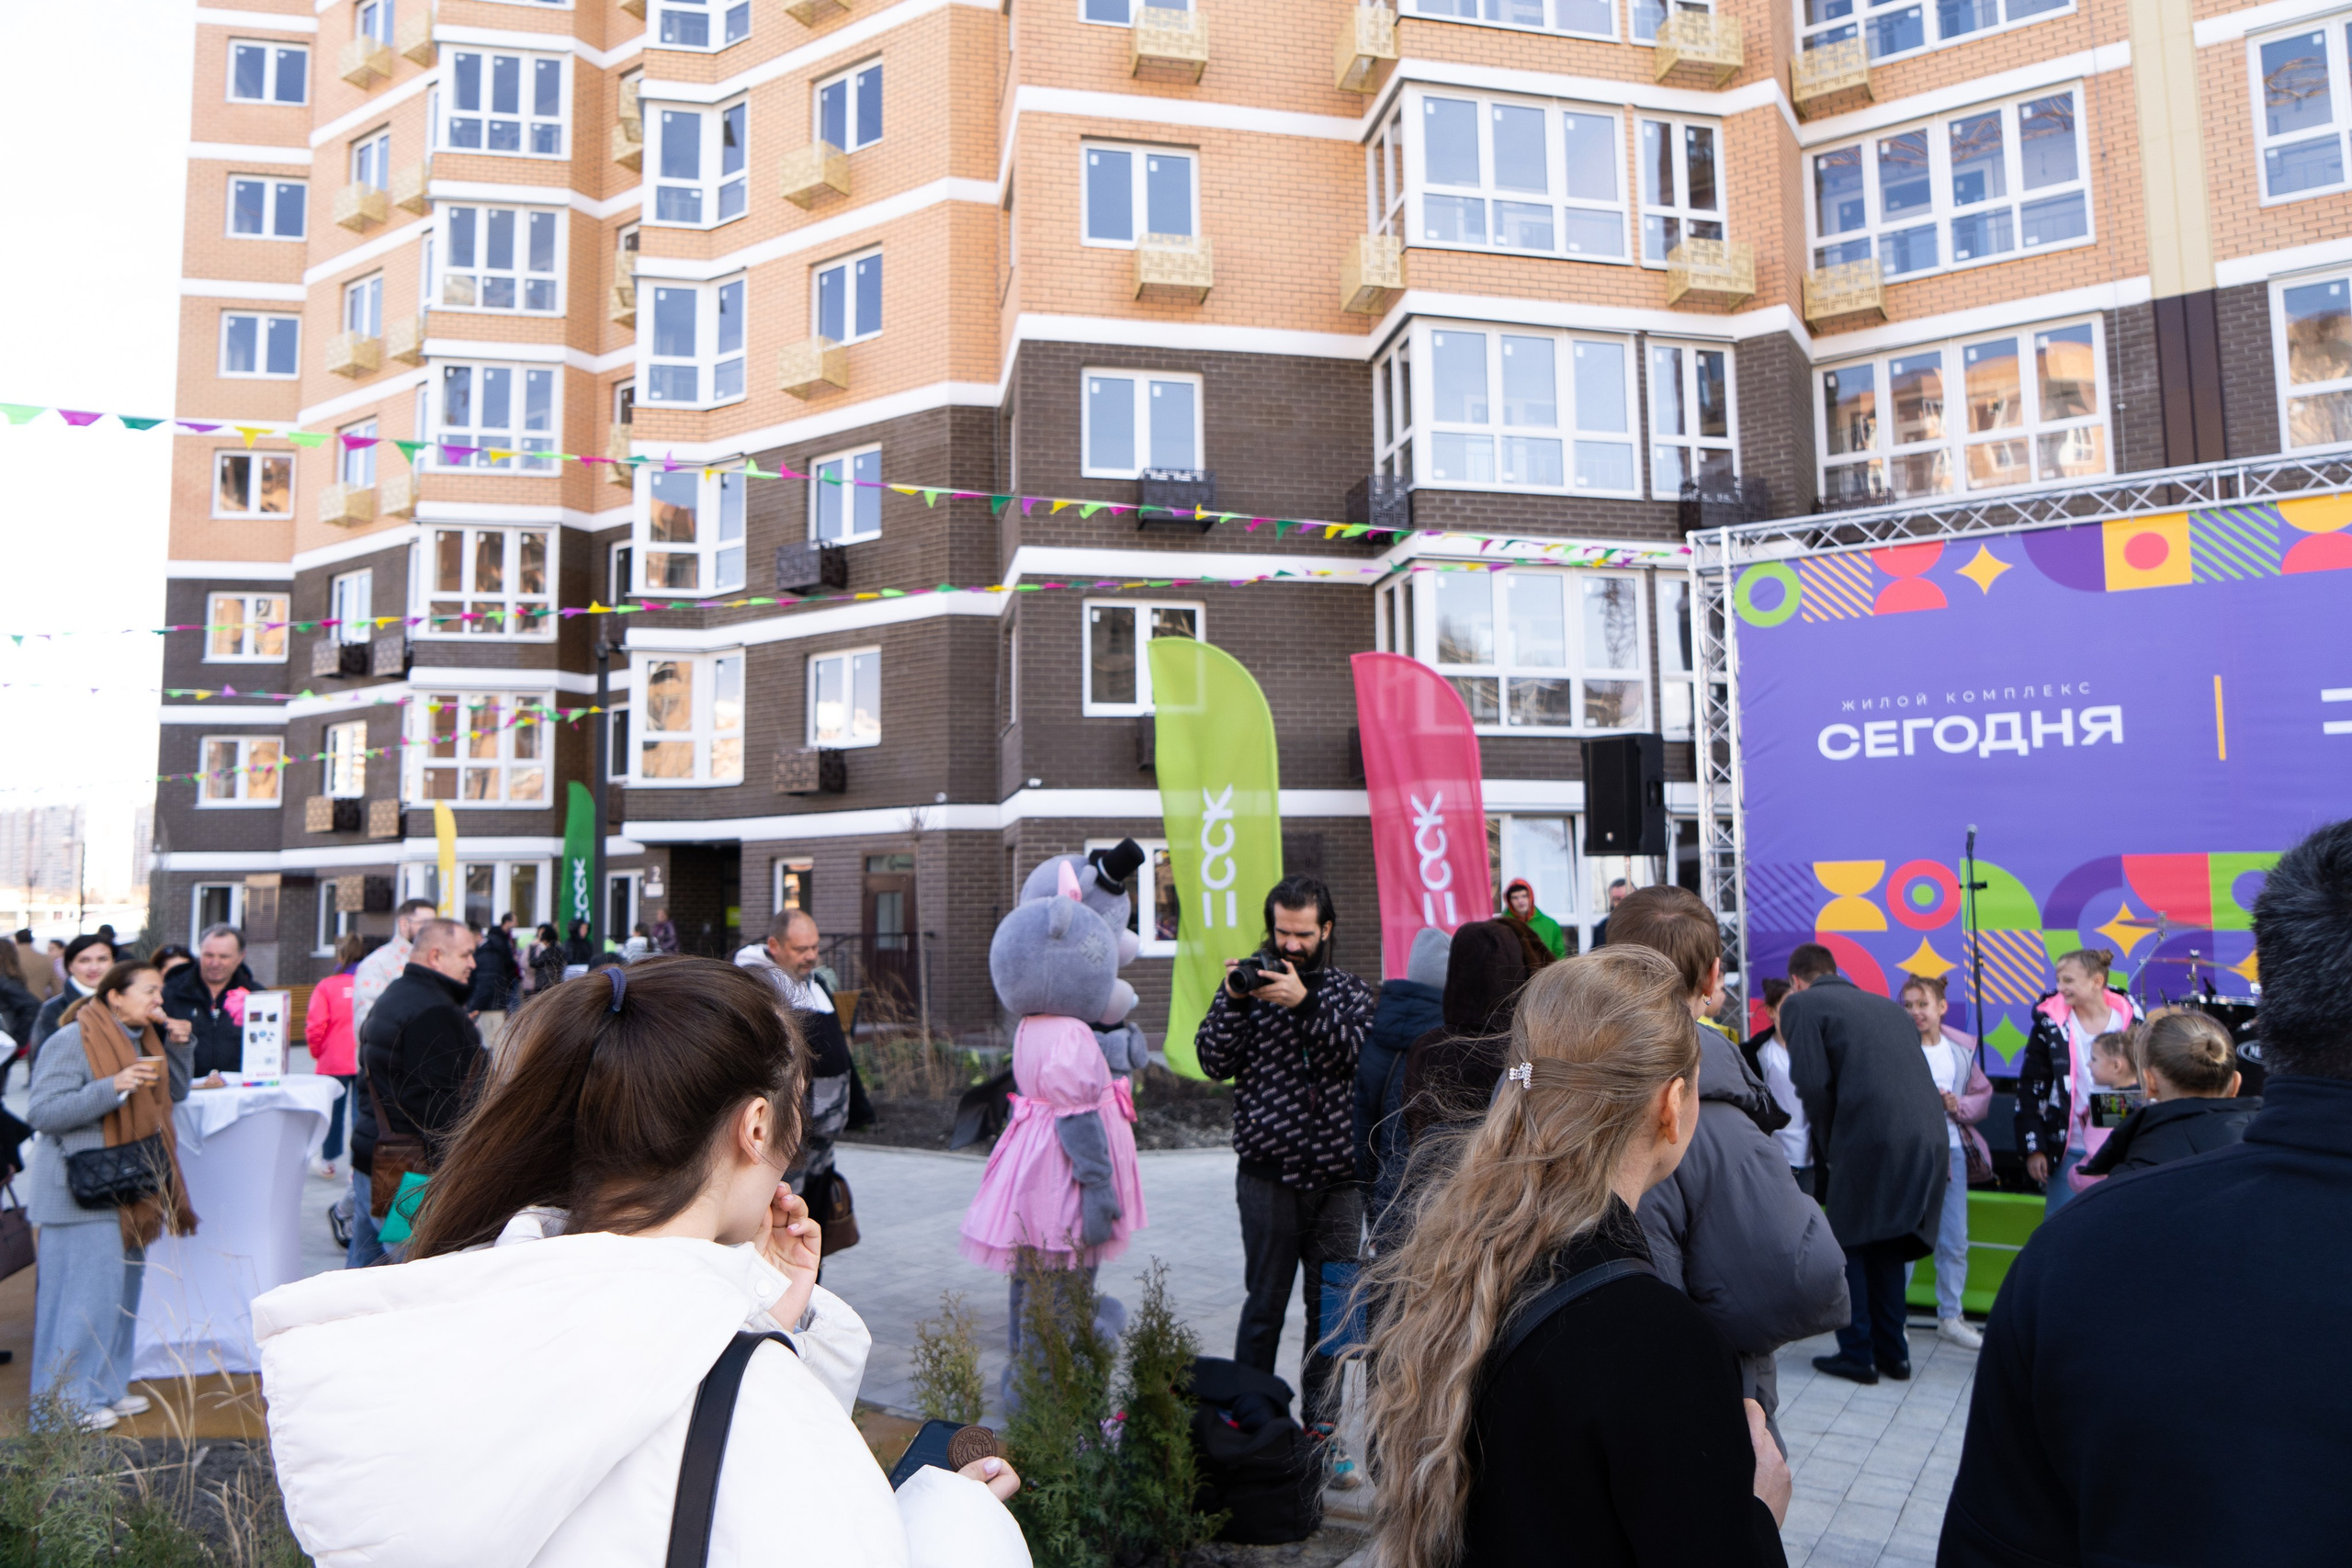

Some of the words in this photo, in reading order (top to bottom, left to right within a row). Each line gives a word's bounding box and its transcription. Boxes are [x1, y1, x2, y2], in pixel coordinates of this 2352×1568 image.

[1841, 692, 1928, 712] ЖИЛОЙ
[1946, 681, 2090, 704] КОМПЛЕКС
[1817, 705, 2123, 761] СЕГОДНЯ
